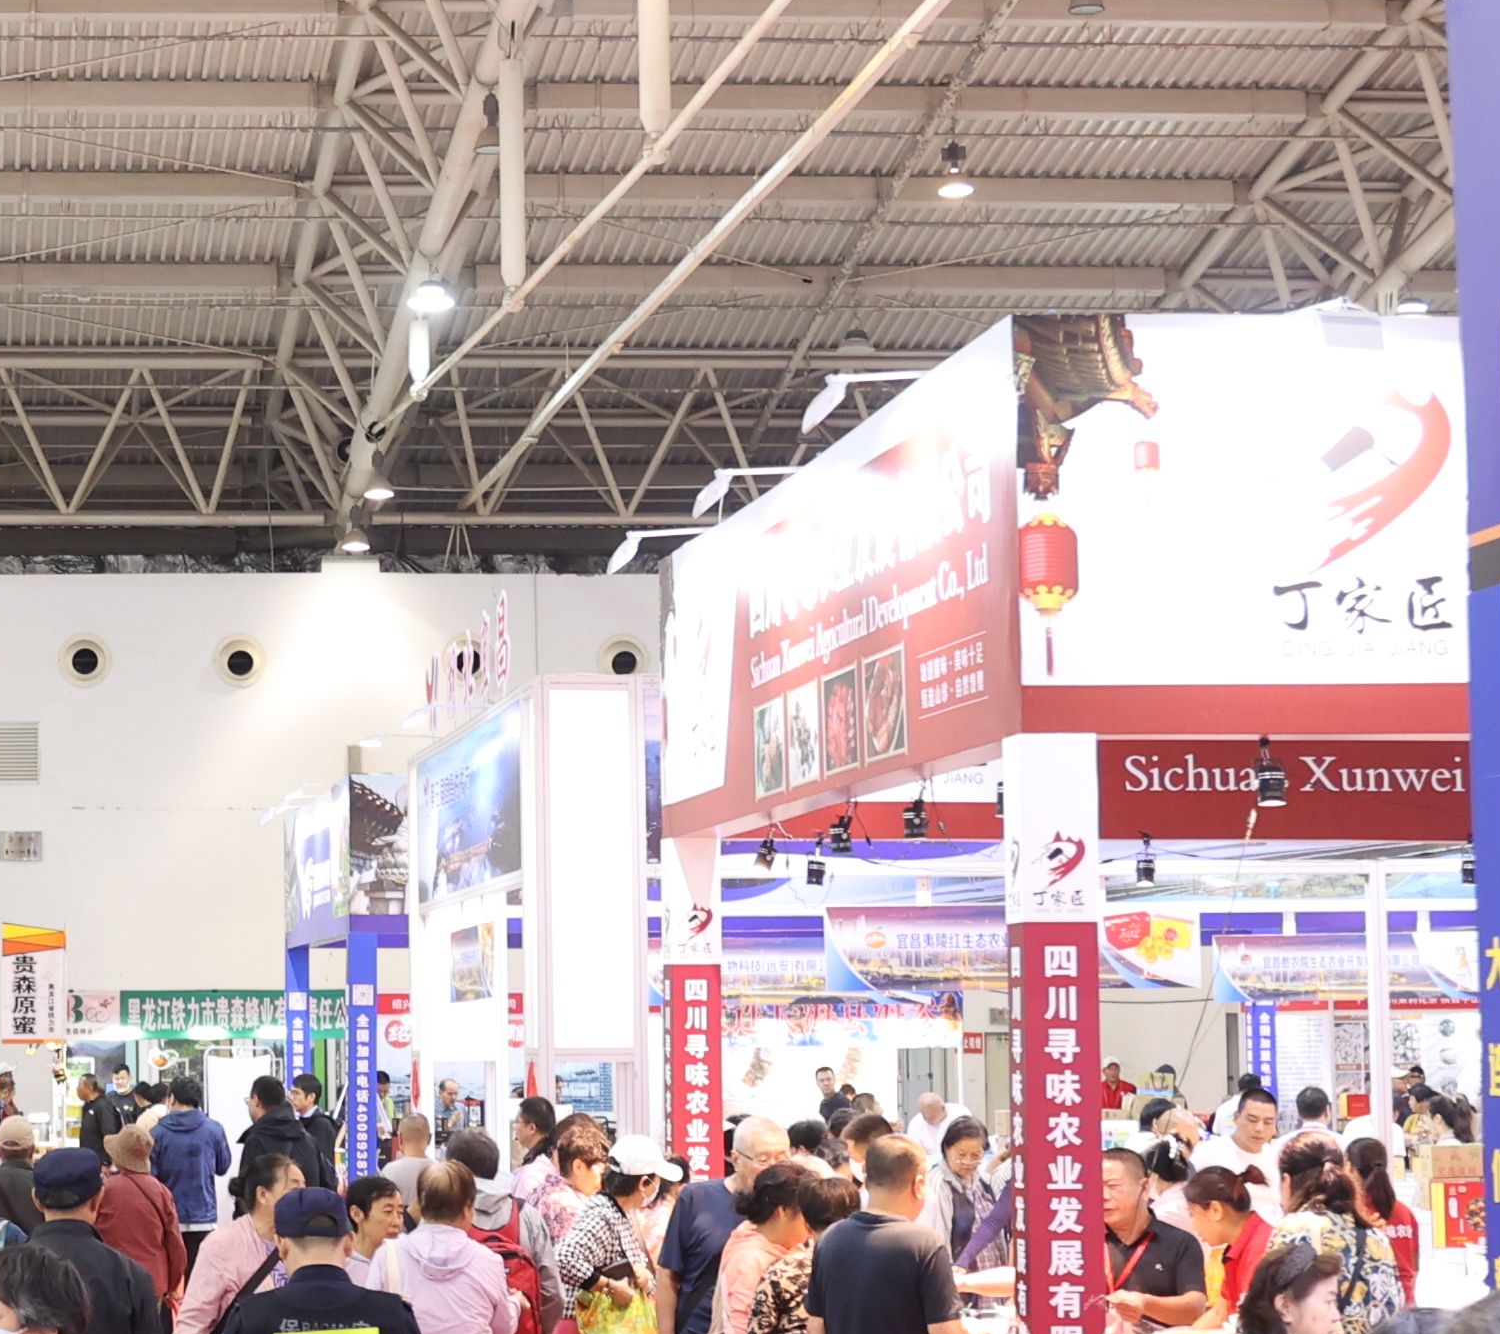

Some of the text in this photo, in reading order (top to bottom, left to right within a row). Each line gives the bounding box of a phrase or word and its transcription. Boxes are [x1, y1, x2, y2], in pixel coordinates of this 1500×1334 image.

[1273, 575, 1454, 634] 丁家匠
[943, 772, 984, 785] JIANG
[1123, 755, 1290, 794] Sichua
[1299, 755, 1466, 794] Xunwei
[1033, 890, 1086, 907] 丁家匠
[12, 955, 37, 1035] 贵森原蜜
[127, 996, 347, 1031] 黑龙江铁力市贵森蜂业有责任公
[684, 978, 710, 1180] 四川寻味农业发
